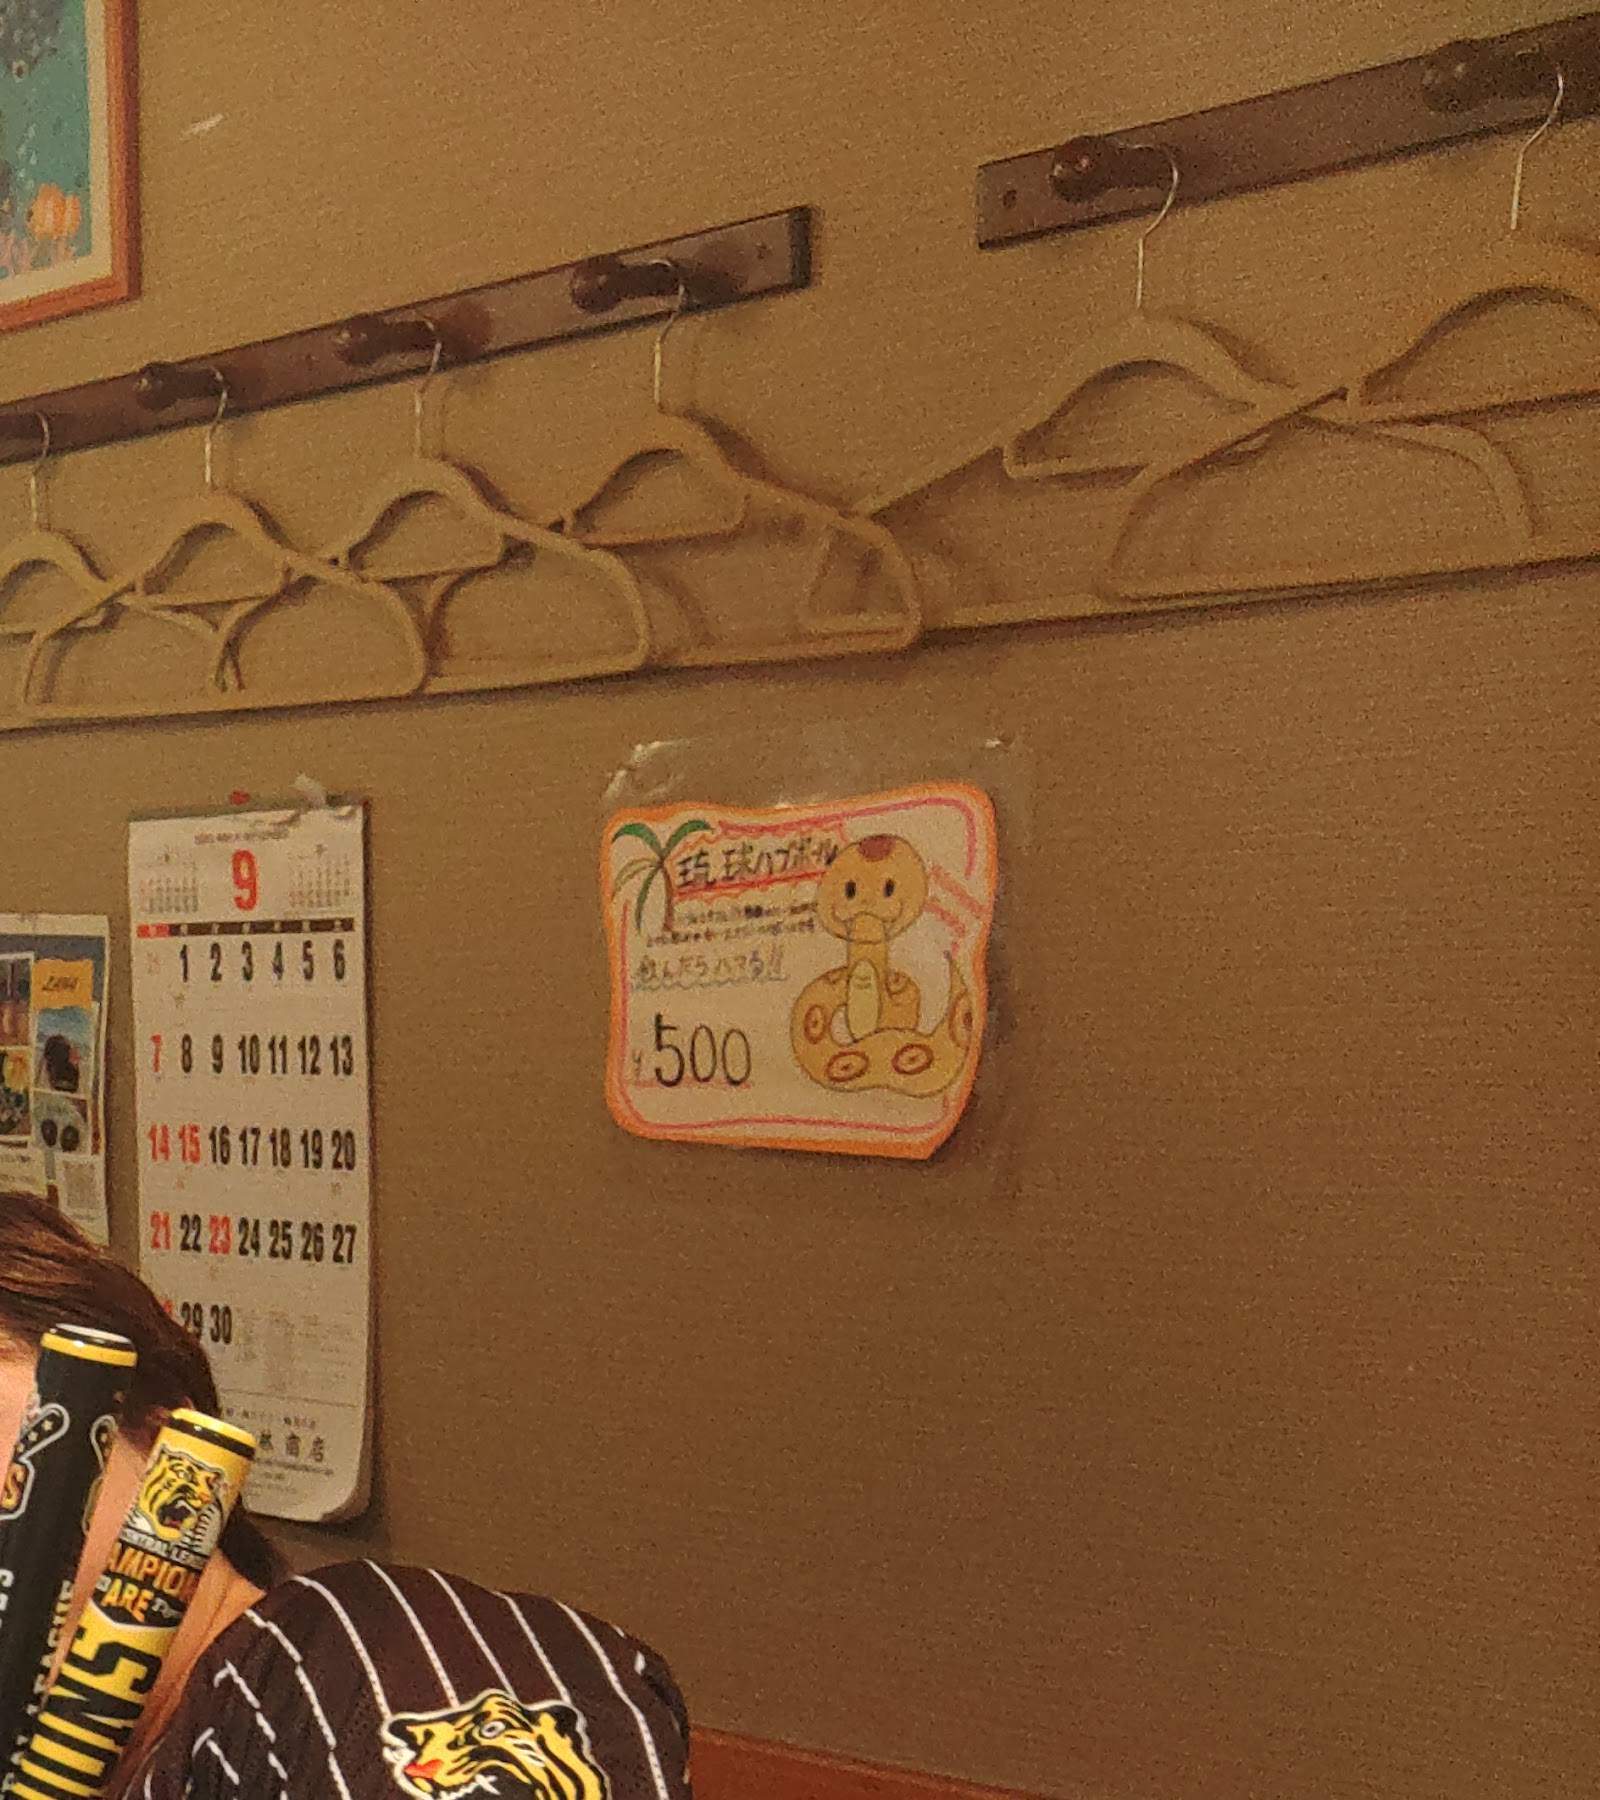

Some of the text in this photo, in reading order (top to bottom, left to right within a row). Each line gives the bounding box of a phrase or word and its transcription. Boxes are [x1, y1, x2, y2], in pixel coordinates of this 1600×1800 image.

[231, 849, 259, 911] 9
[179, 938, 346, 982] 1 2 3 4 5 6
[151, 1034, 353, 1076] 7 8 9 10 11 12 13
[147, 1123, 356, 1171] 14 15 16 17 18 19 20
[150, 1210, 356, 1265] 21 22 23 24 25 26 27
[181, 1301, 232, 1345] 29 30
[106, 1540, 201, 1603] AMPION
